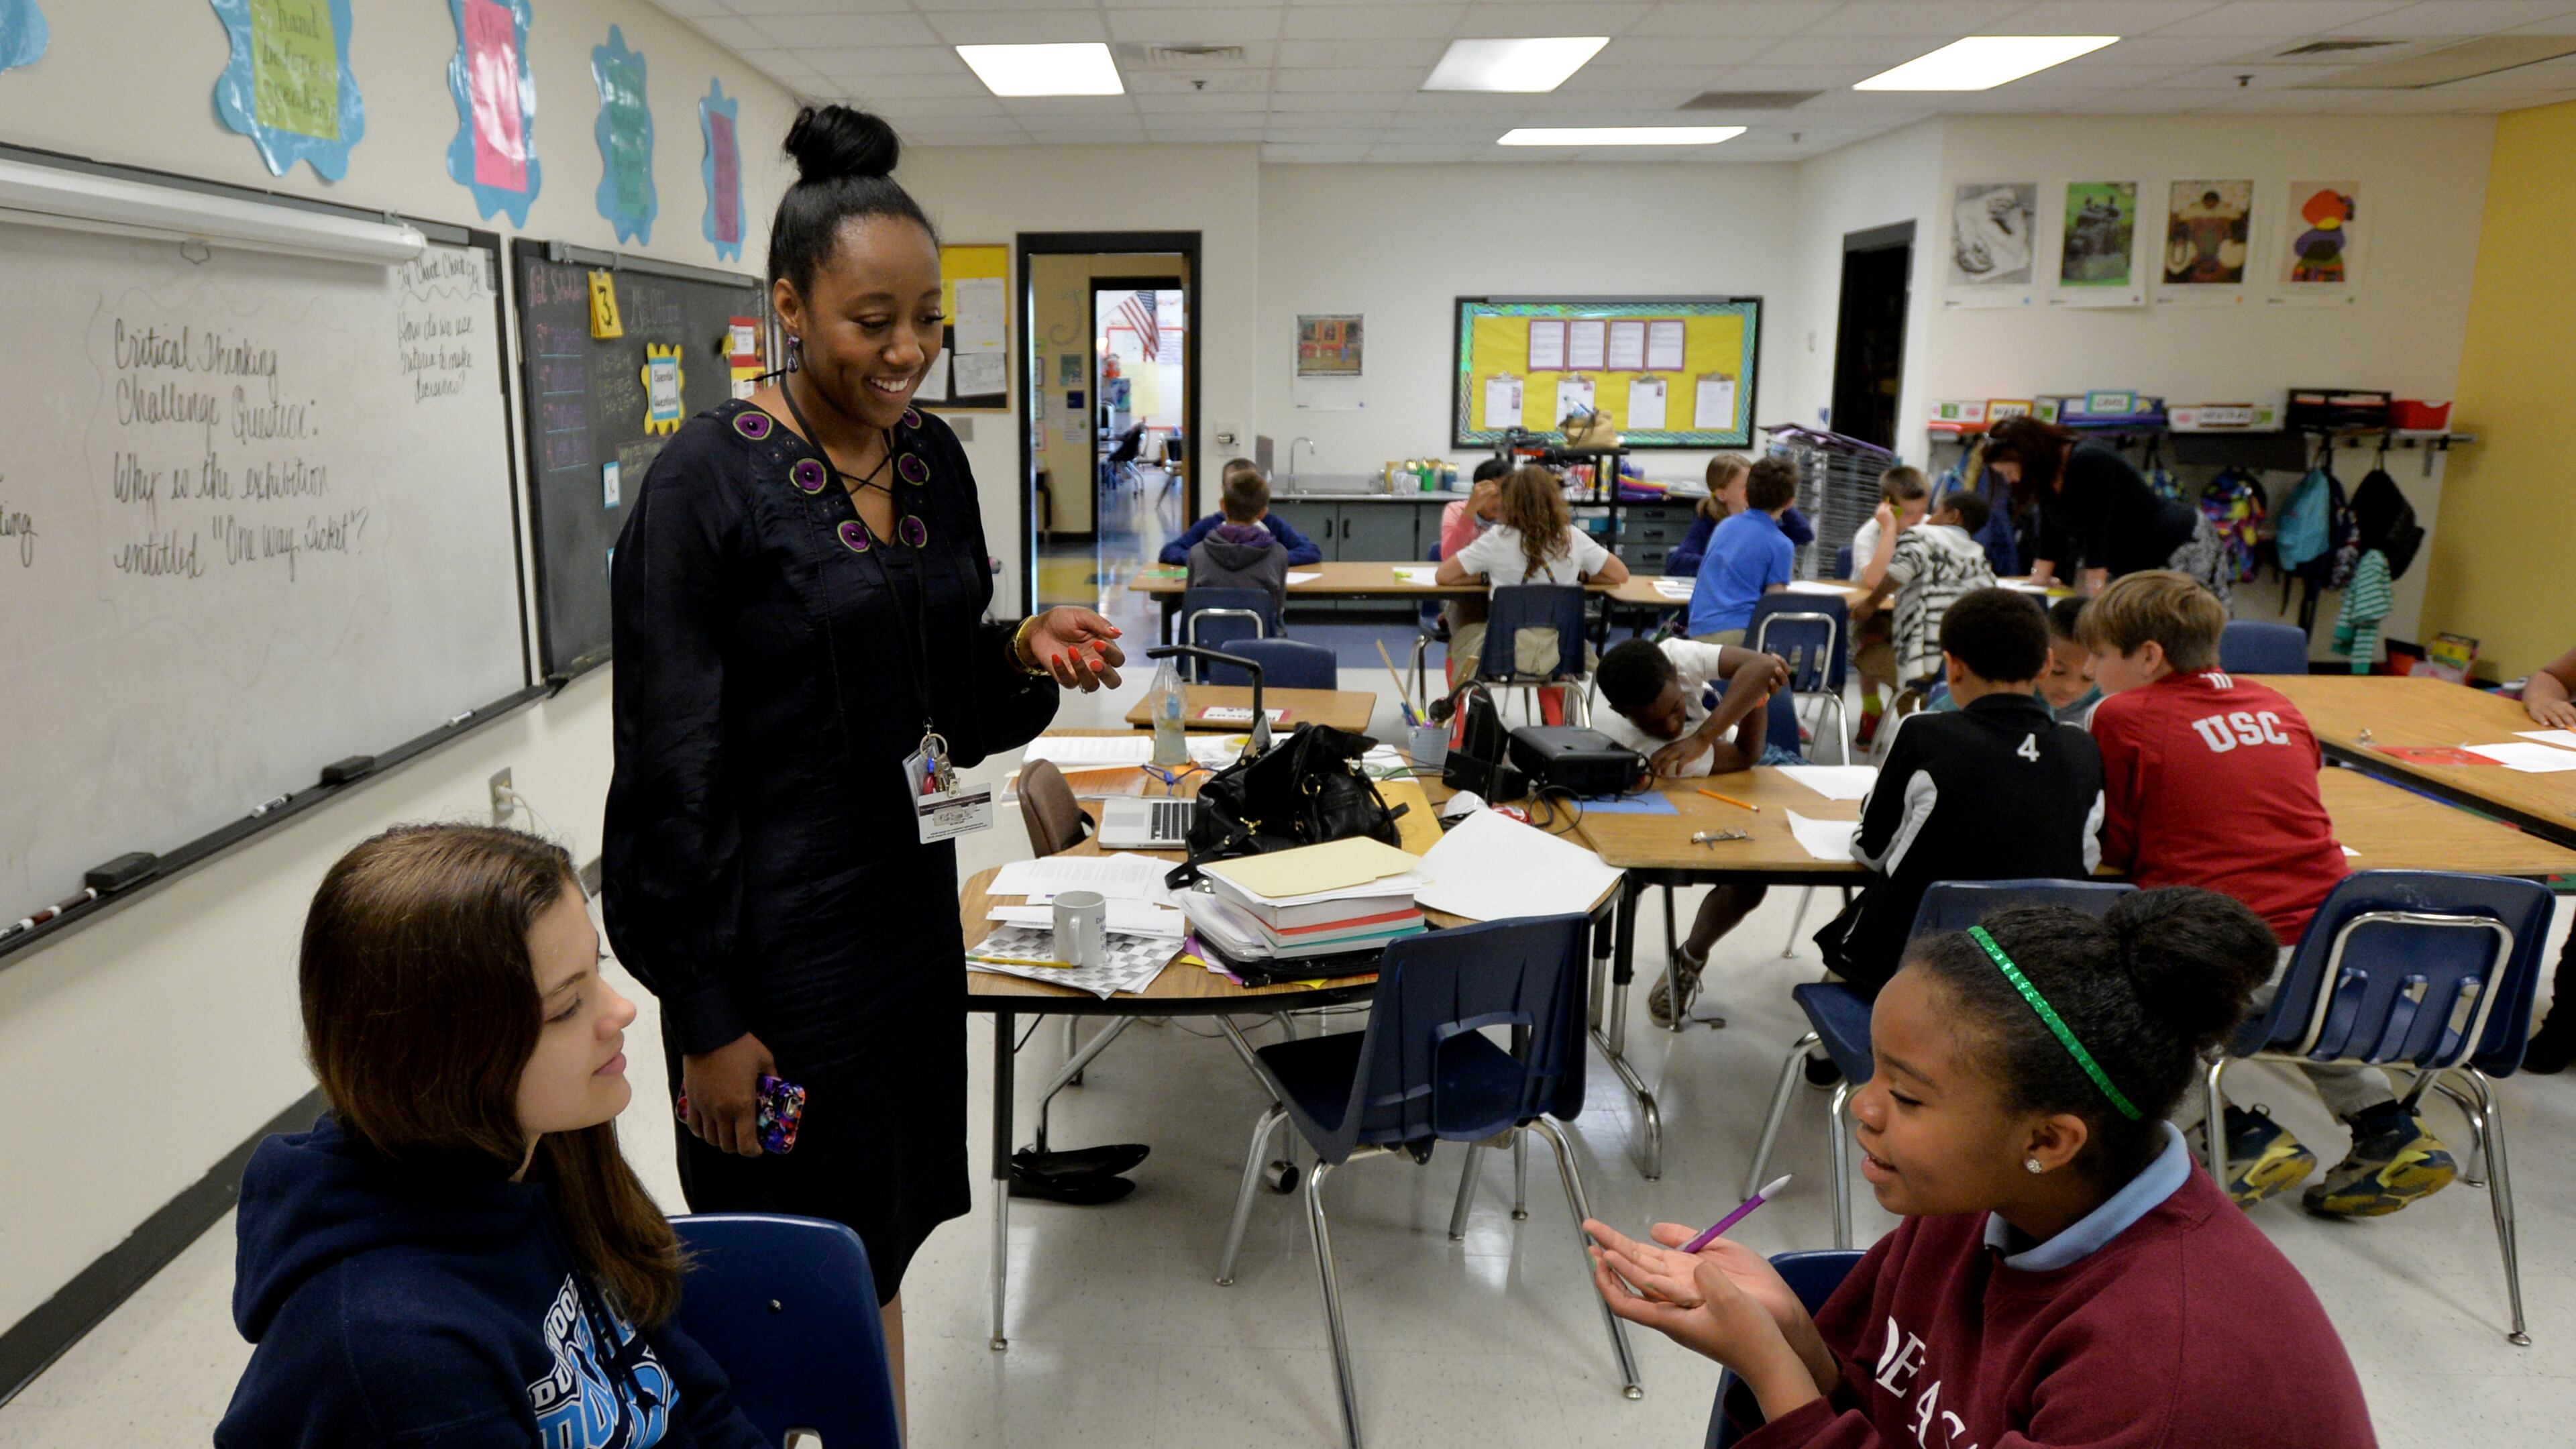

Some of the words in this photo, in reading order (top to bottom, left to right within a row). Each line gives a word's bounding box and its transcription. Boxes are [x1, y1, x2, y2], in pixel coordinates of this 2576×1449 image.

[424, 312, 436, 340] do
[439, 319, 451, 337] we
[597, 284, 613, 328] 3
[115, 317, 193, 372] Critical
[197, 331, 277, 403] Thinking
[116, 374, 219, 457] Challenge
[114, 451, 161, 529] Why
[195, 451, 233, 500] the
[241, 457, 329, 502] exhibition
[113, 530, 205, 578] entitled
[2017, 733, 2040, 762] 4
[2192, 711, 2289, 753] USC
